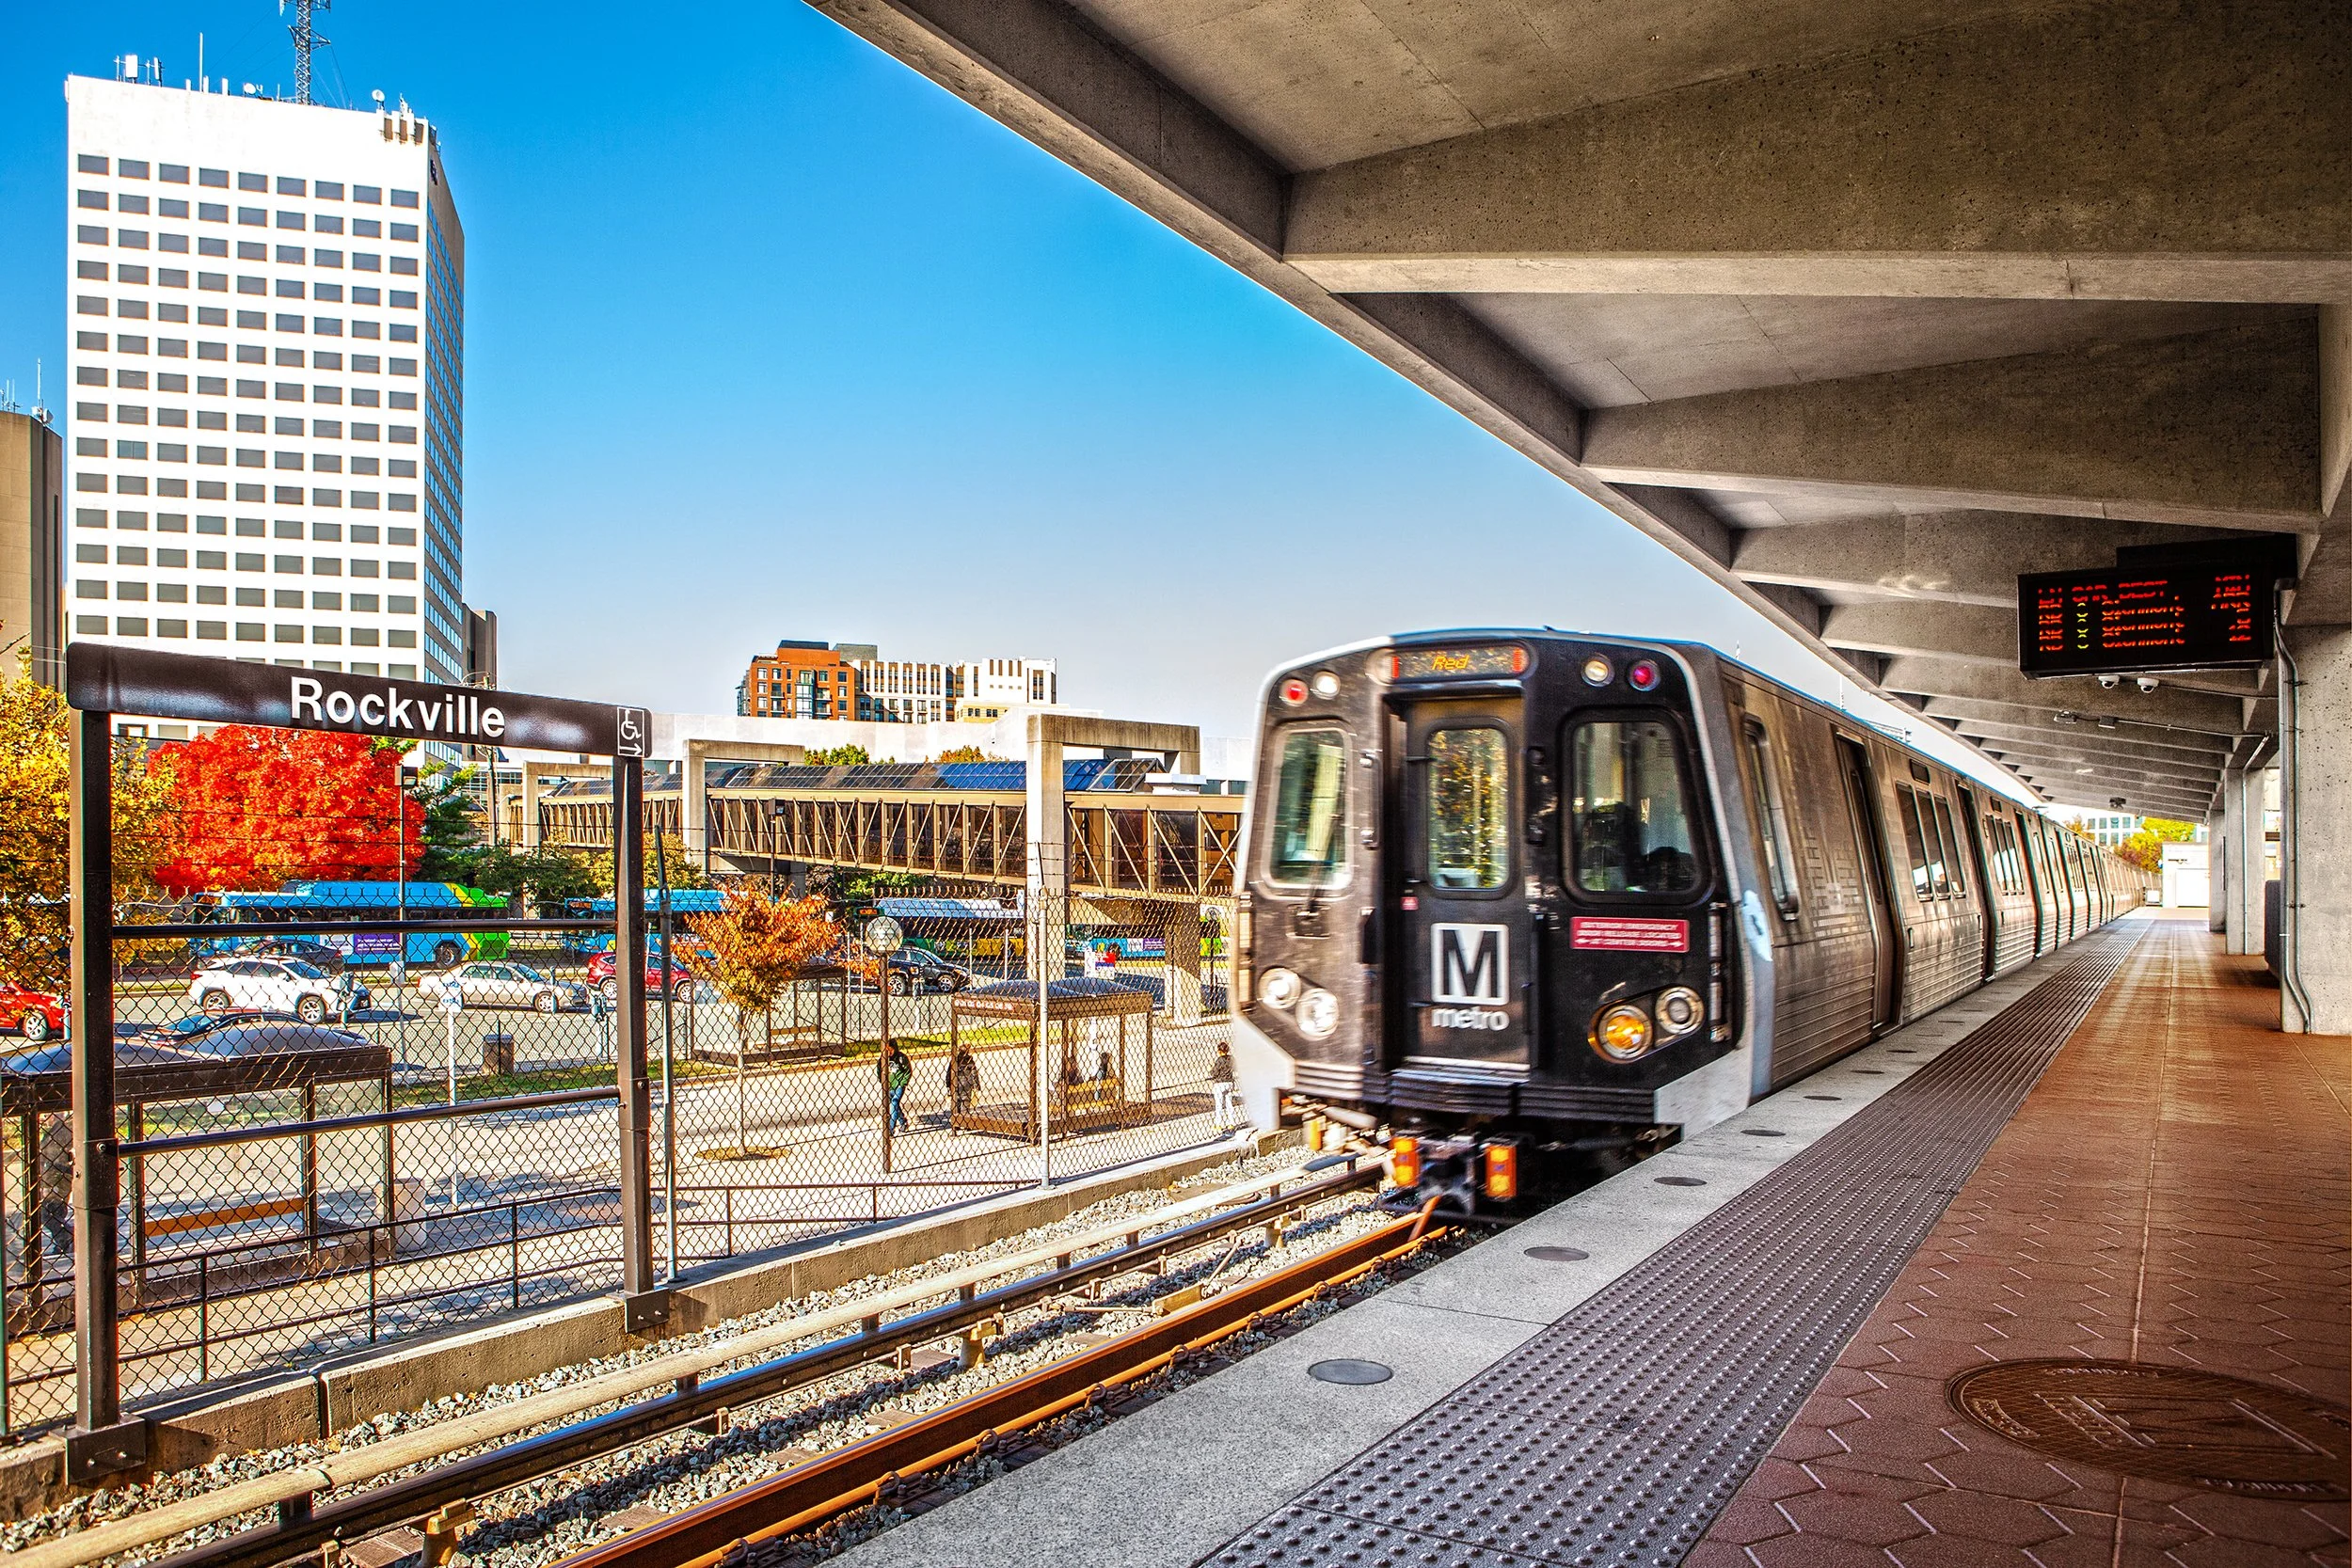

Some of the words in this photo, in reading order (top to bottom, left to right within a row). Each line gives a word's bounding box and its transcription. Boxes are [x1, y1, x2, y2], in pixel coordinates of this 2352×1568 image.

[1431, 654, 1470, 671] Red
[290, 675, 506, 738] Rockville
[1441, 928, 1499, 999] M
[1430, 1006, 1510, 1031] metro
